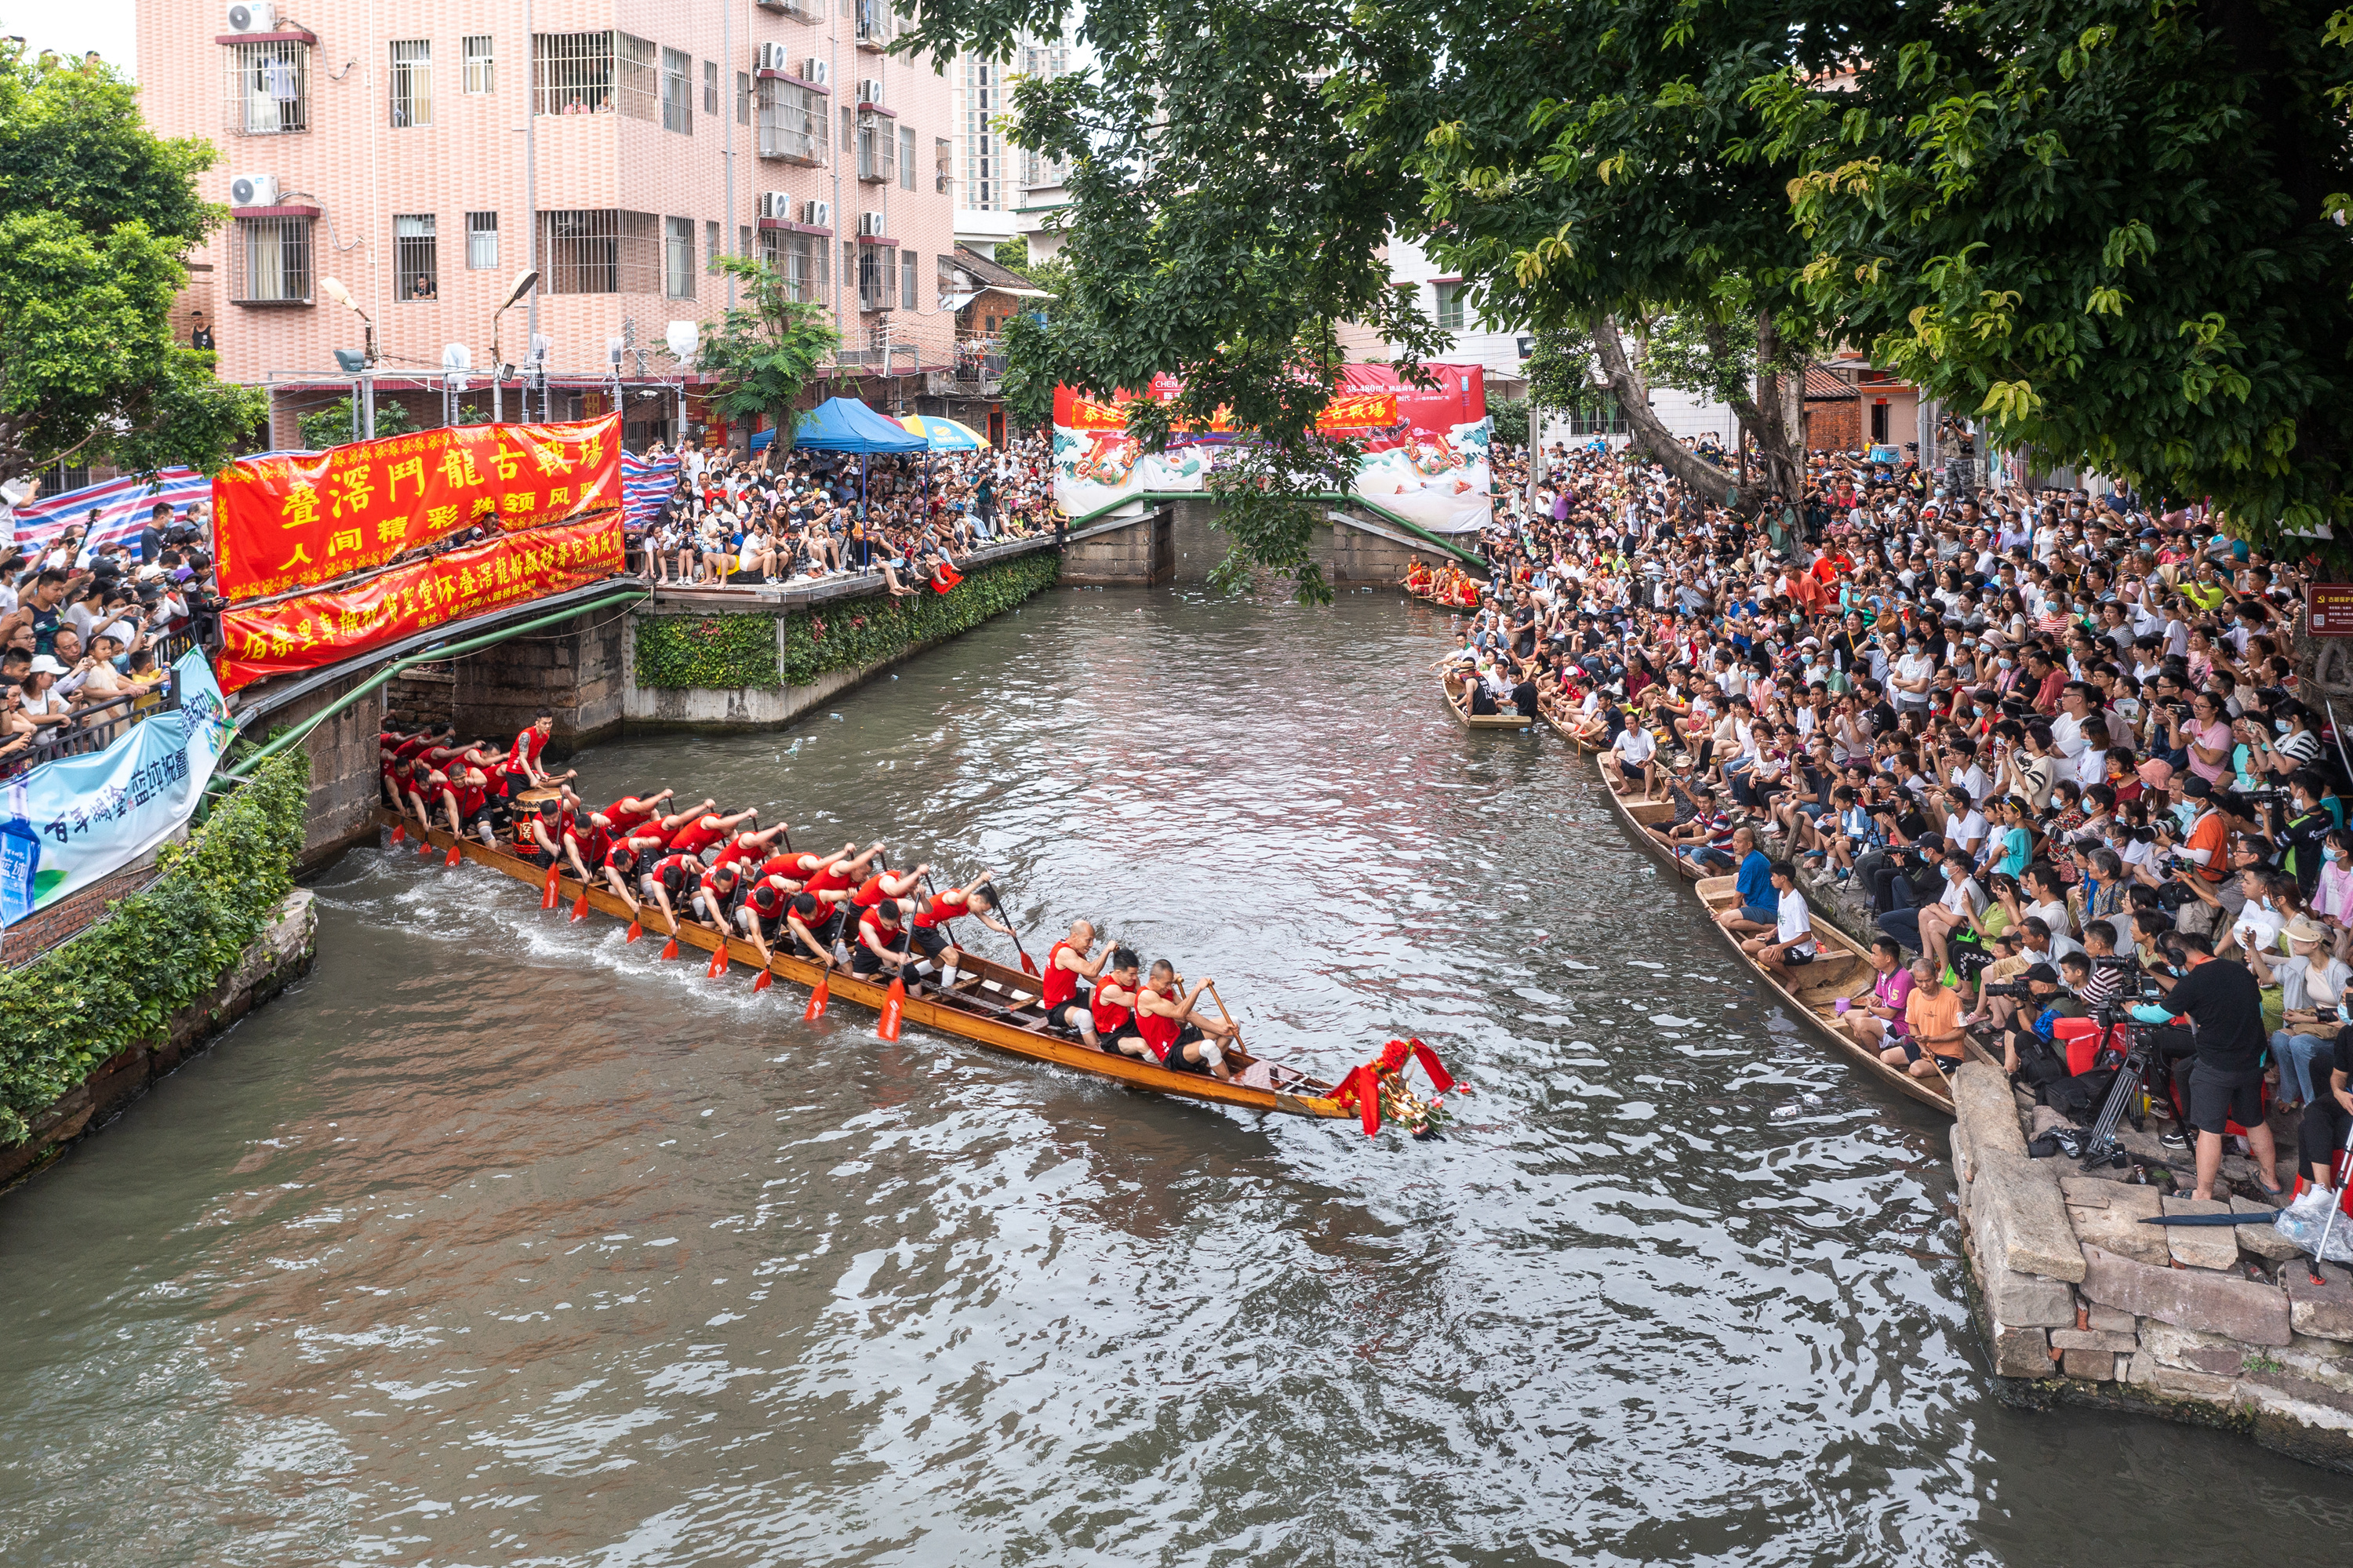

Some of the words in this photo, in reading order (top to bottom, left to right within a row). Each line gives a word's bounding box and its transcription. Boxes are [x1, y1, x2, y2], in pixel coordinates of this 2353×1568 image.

[278, 480, 602, 571] 人间精彩独领风骚
[418, 613, 442, 628] 地址：
[1891, 988, 1900, 1001] 5
